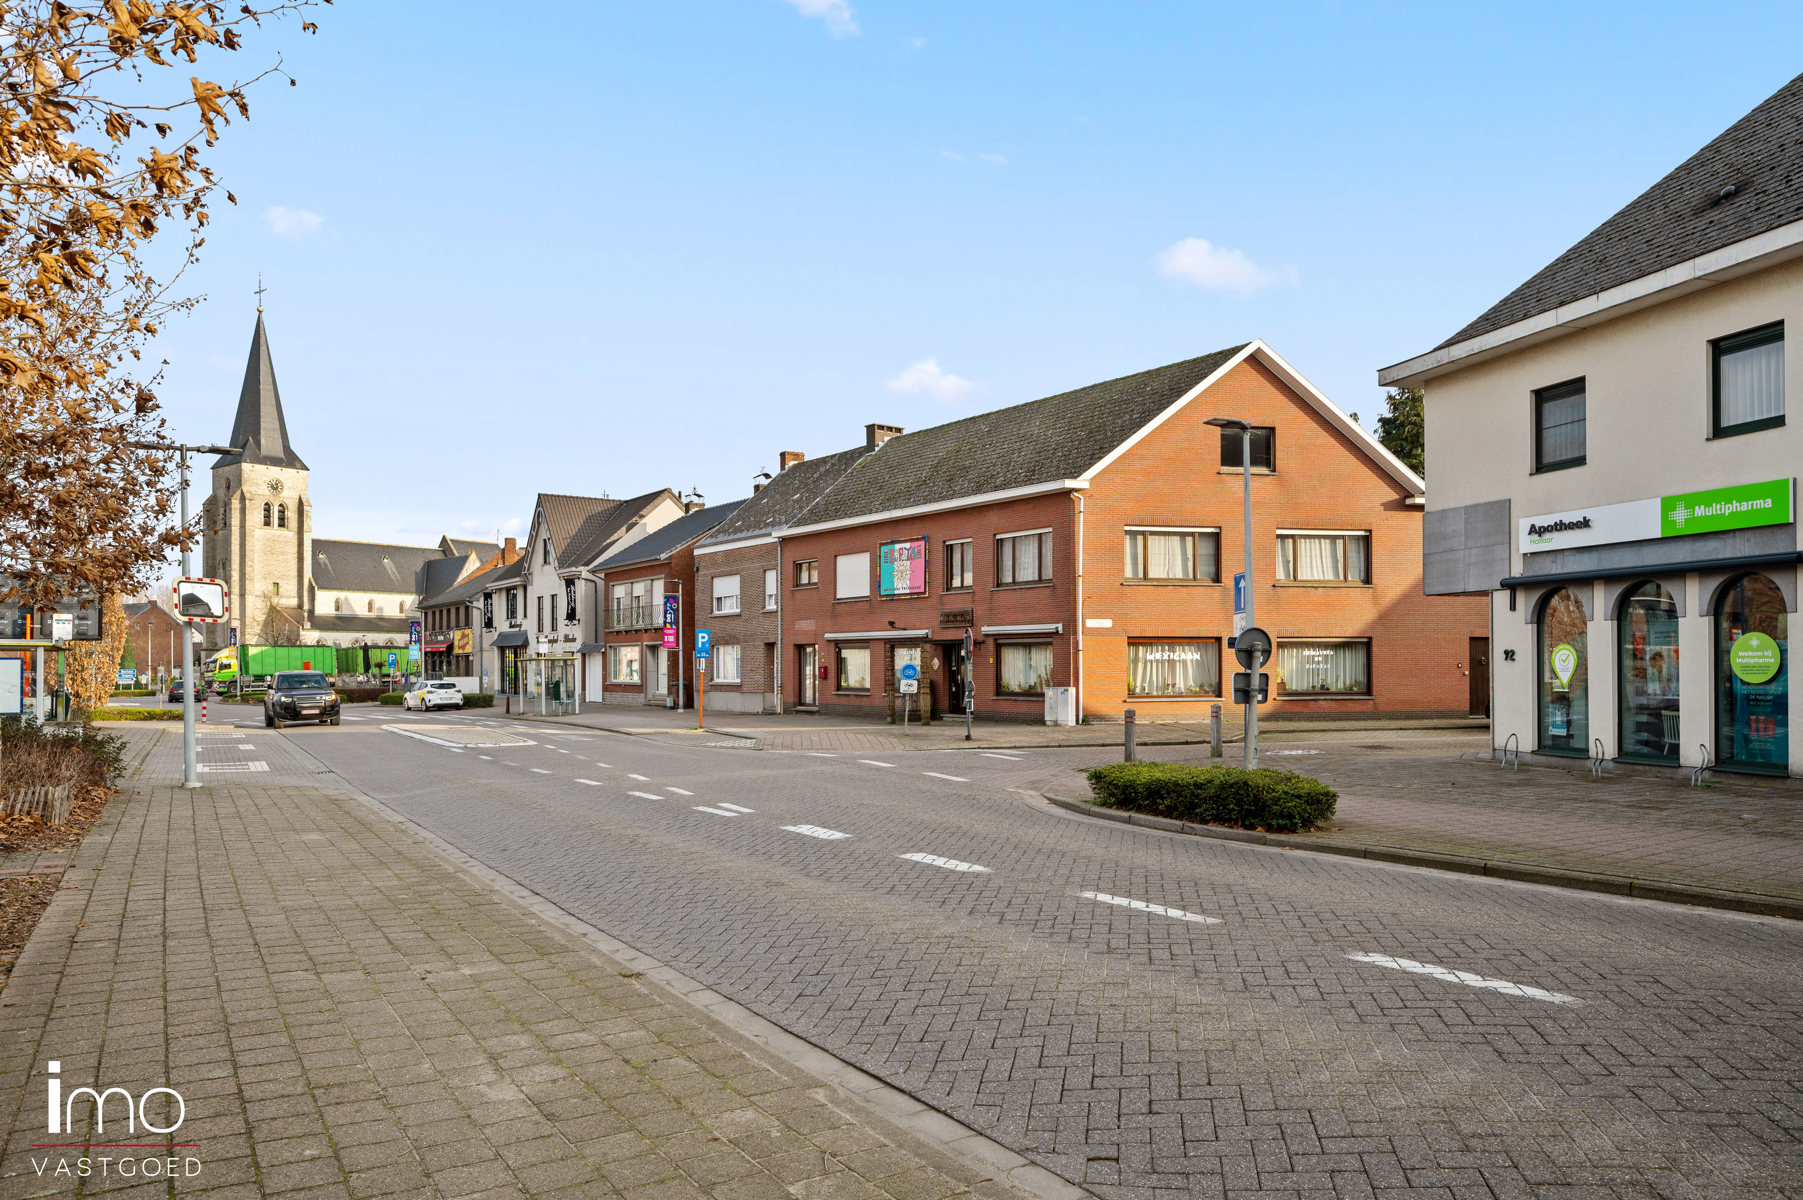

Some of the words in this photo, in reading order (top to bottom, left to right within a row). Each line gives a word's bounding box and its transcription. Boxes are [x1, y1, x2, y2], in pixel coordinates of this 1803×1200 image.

[1694, 498, 1772, 517] Multipharma
[1527, 515, 1592, 537] Apotheek
[1529, 536, 1554, 545] Hallaar
[698, 632, 708, 648] P
[1146, 651, 1201, 660] MEXICAAN
[1503, 649, 1516, 661] 92
[1763, 650, 1772, 658] bij
